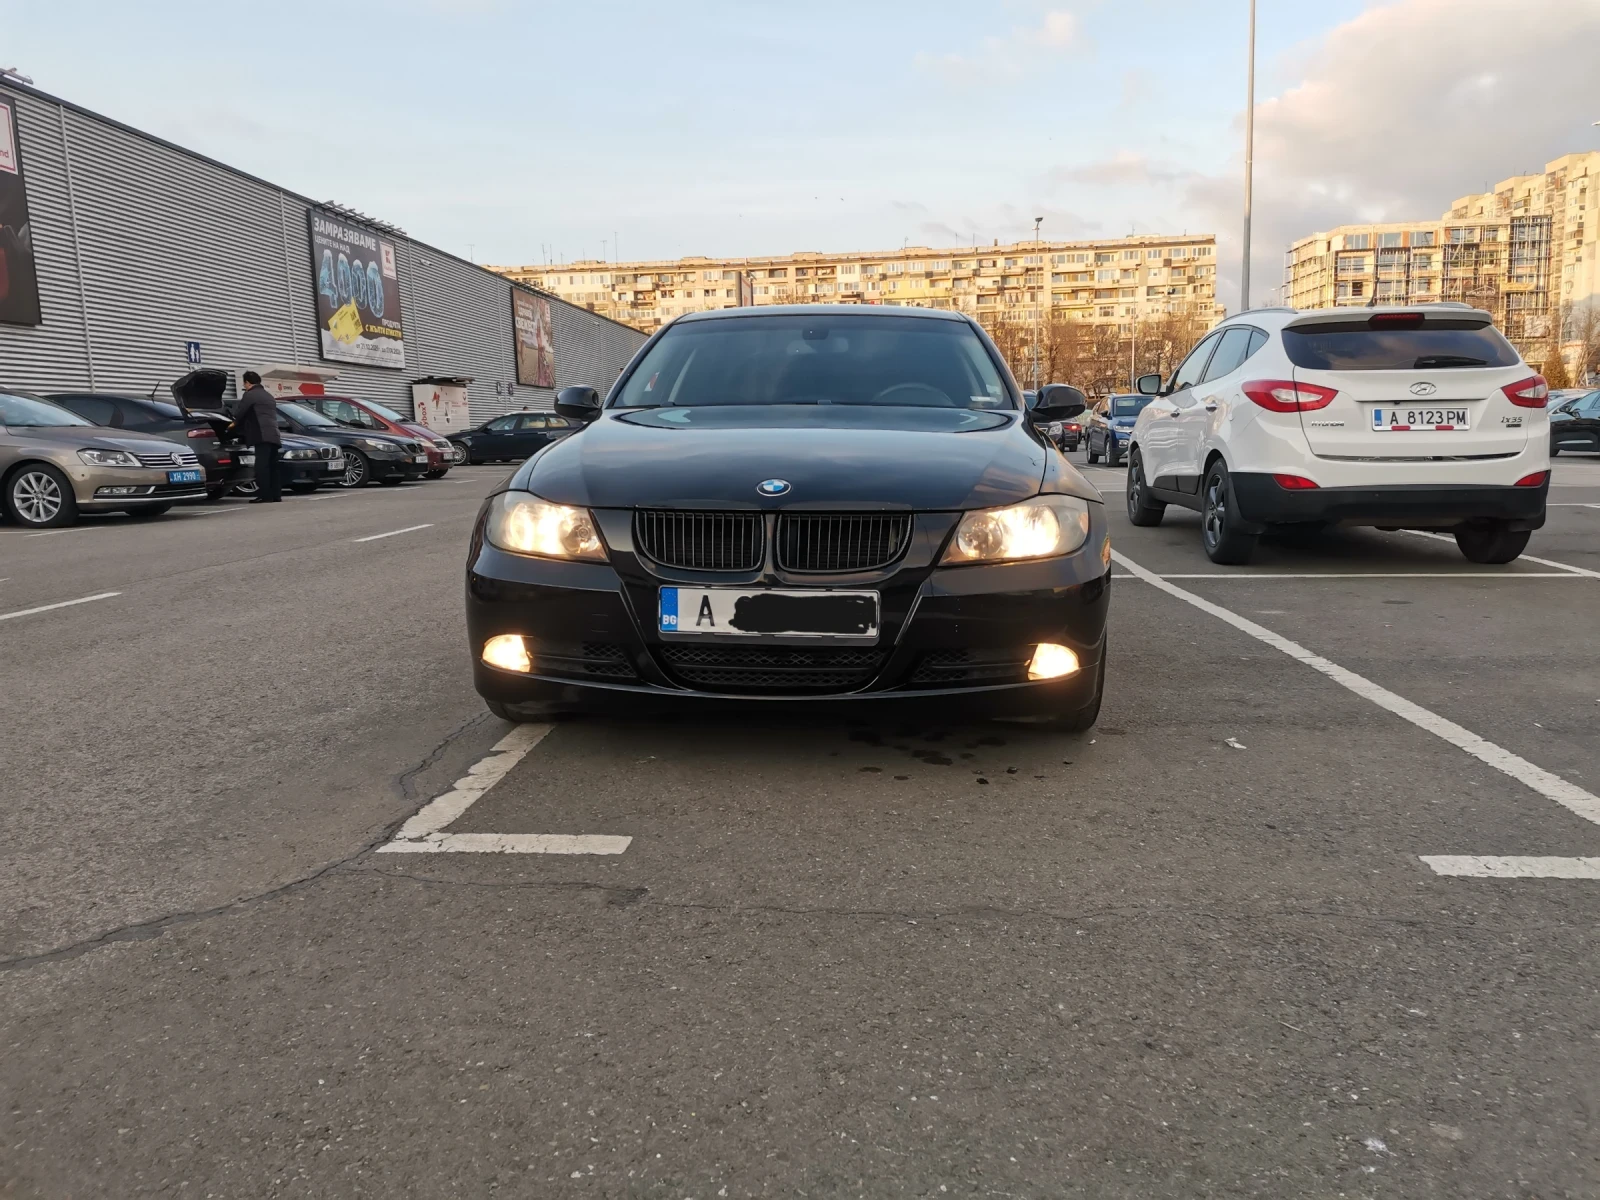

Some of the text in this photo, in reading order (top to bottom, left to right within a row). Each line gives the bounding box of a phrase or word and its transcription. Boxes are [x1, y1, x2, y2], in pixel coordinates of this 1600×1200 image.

[314, 217, 376, 251] ЗАМРАЗЯВАМЕ
[319, 249, 384, 318] 4000
[1390, 411, 1399, 425] A
[662, 614, 677, 625] BG
[696, 595, 715, 627] A
